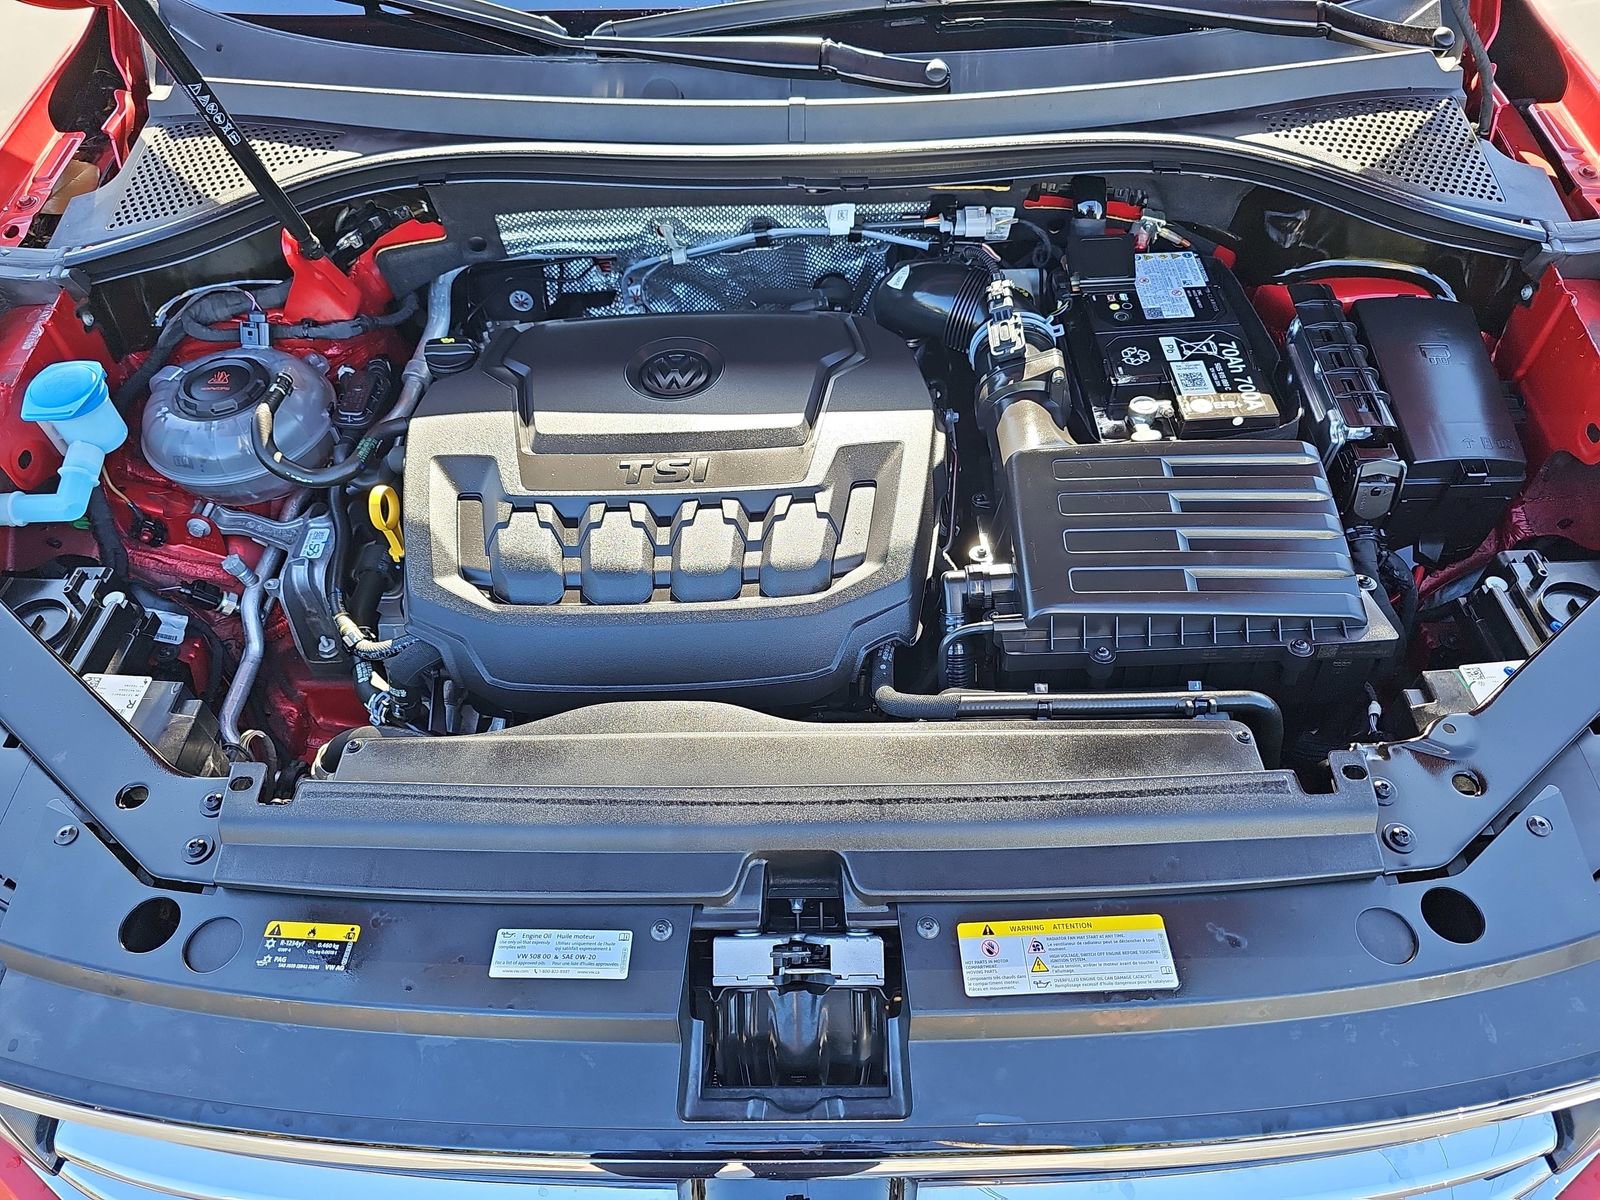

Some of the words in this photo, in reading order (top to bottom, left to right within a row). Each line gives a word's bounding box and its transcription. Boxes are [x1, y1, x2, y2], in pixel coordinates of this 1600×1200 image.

[1164, 344, 1174, 354] Pb
[1218, 341, 1246, 374] 70Ah
[1234, 376, 1266, 411] 700A
[619, 457, 711, 485] TSI
[126, 700, 137, 709] R
[1009, 924, 1044, 932] WARNING
[1052, 922, 1093, 930] ATTENTION
[522, 933, 542, 941] Engine
[333, 942, 340, 950] kg
